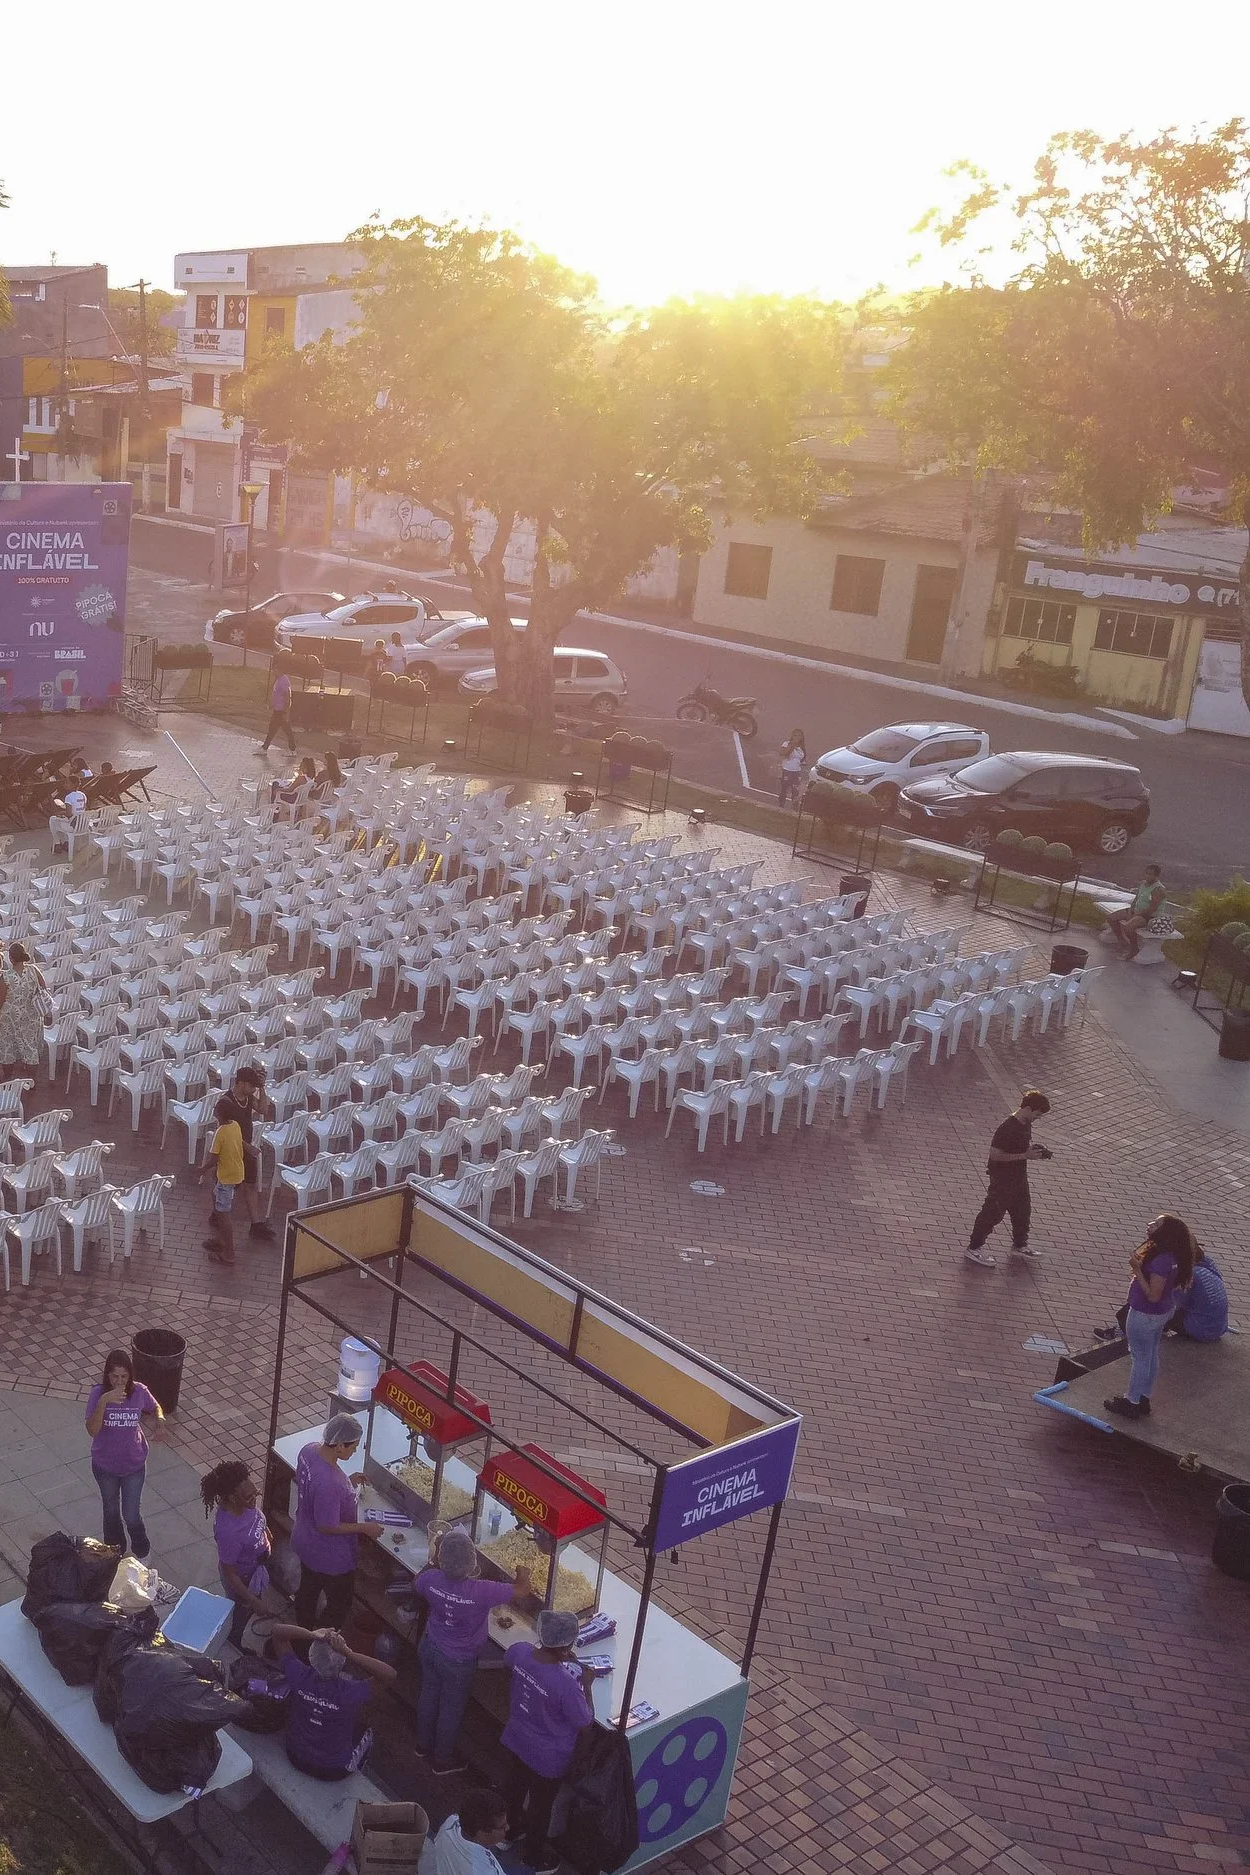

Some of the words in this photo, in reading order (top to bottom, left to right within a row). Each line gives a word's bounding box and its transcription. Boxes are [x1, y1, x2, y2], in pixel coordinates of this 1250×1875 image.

[6, 532, 84, 550] CINEMA
[36, 576, 70, 584] GRATUITO
[1024, 560, 1190, 604] Franguinho
[75, 592, 113, 610] PIPOCA
[80, 600, 118, 620] GRÁTIS!
[54, 650, 87, 659] BRASIL
[388, 1384, 433, 1427] PIPOCA
[108, 1412, 139, 1420] CINEMA
[698, 1468, 757, 1503] CINEMA
[495, 1472, 546, 1520] PIPOCA
[681, 1484, 764, 1528] INFLÁVEL
